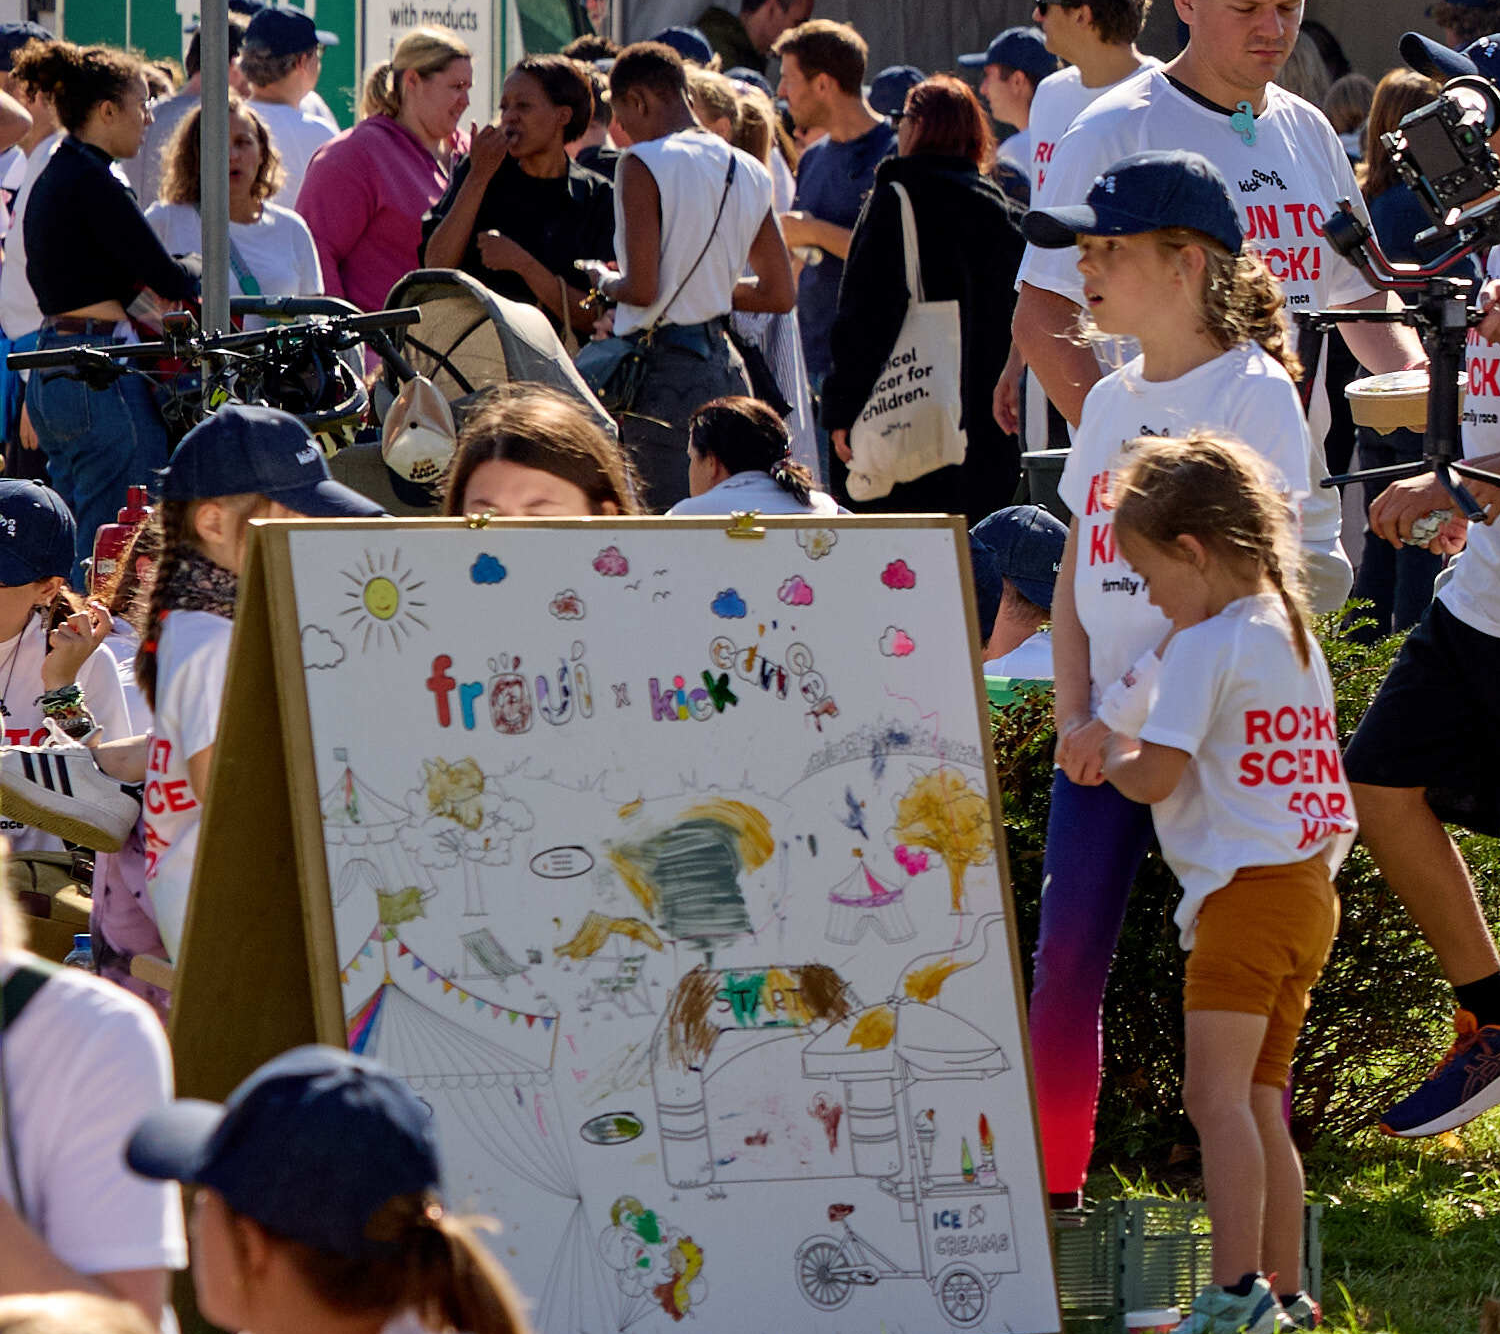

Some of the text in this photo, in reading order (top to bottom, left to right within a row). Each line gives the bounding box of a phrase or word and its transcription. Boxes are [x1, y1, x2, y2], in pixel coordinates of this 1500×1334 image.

[389, 8, 418, 30] with
[907, 365, 933, 382] for
[862, 386, 930, 422] children.
[647, 668, 739, 723] kick
[714, 987, 805, 1014] START
[932, 1210, 963, 1231] ICE
[933, 1233, 1010, 1257] CREAMS
